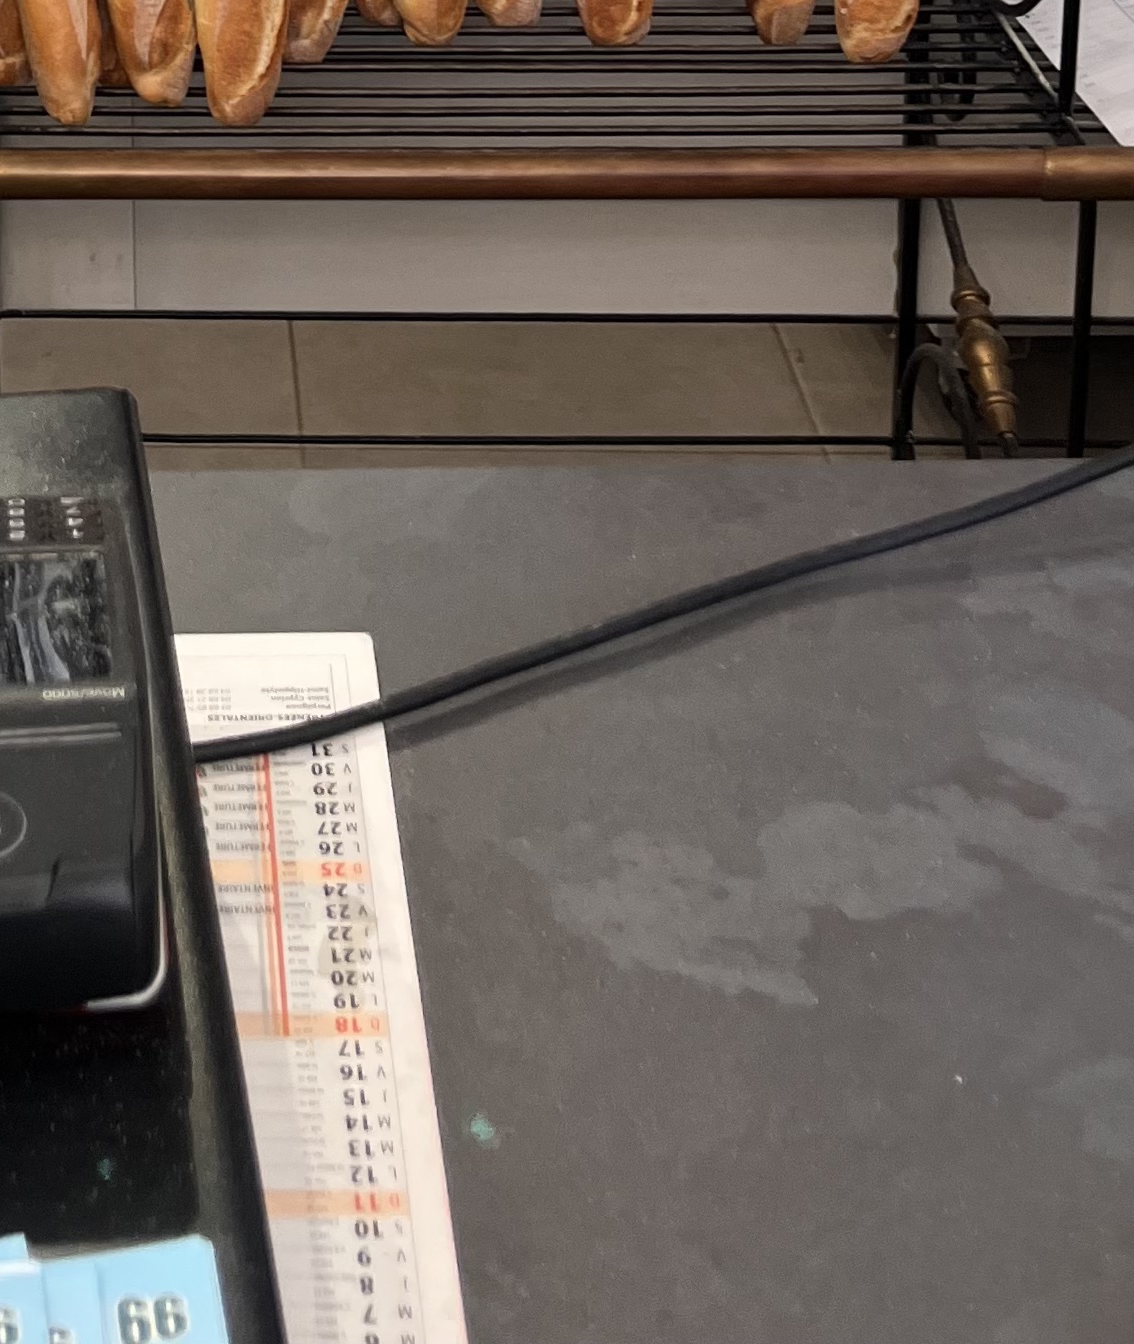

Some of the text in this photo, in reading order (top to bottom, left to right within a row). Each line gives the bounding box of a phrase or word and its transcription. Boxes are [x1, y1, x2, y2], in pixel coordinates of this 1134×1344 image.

[311, 743, 332, 757] 31
[311, 763, 335, 776] 30
[313, 782, 337, 795] 29
[314, 802, 355, 815] M 28
[318, 821, 358, 835] M 27
[319, 841, 343, 856] 26
[321, 862, 345, 876] 25
[323, 883, 347, 897] 24
[326, 904, 350, 919] 23
[328, 926, 352, 940] 22
[331, 948, 372, 963] M 21
[331, 971, 374, 986] M 20
[334, 993, 360, 1008] 19
[335, 1017, 361, 1033] 18
[339, 1040, 364, 1056] 17
[340, 1064, 367, 1081] 16
[343, 1089, 369, 1105] 15
[346, 1115, 391, 1131] M 14
[348, 1140, 393, 1158] M 13
[351, 1166, 377, 1184] 12
[355, 1193, 380, 1212] 11
[355, 1220, 383, 1239] 10
[117, 1293, 188, 1344] 66
[364, 1304, 412, 1325] M 7
